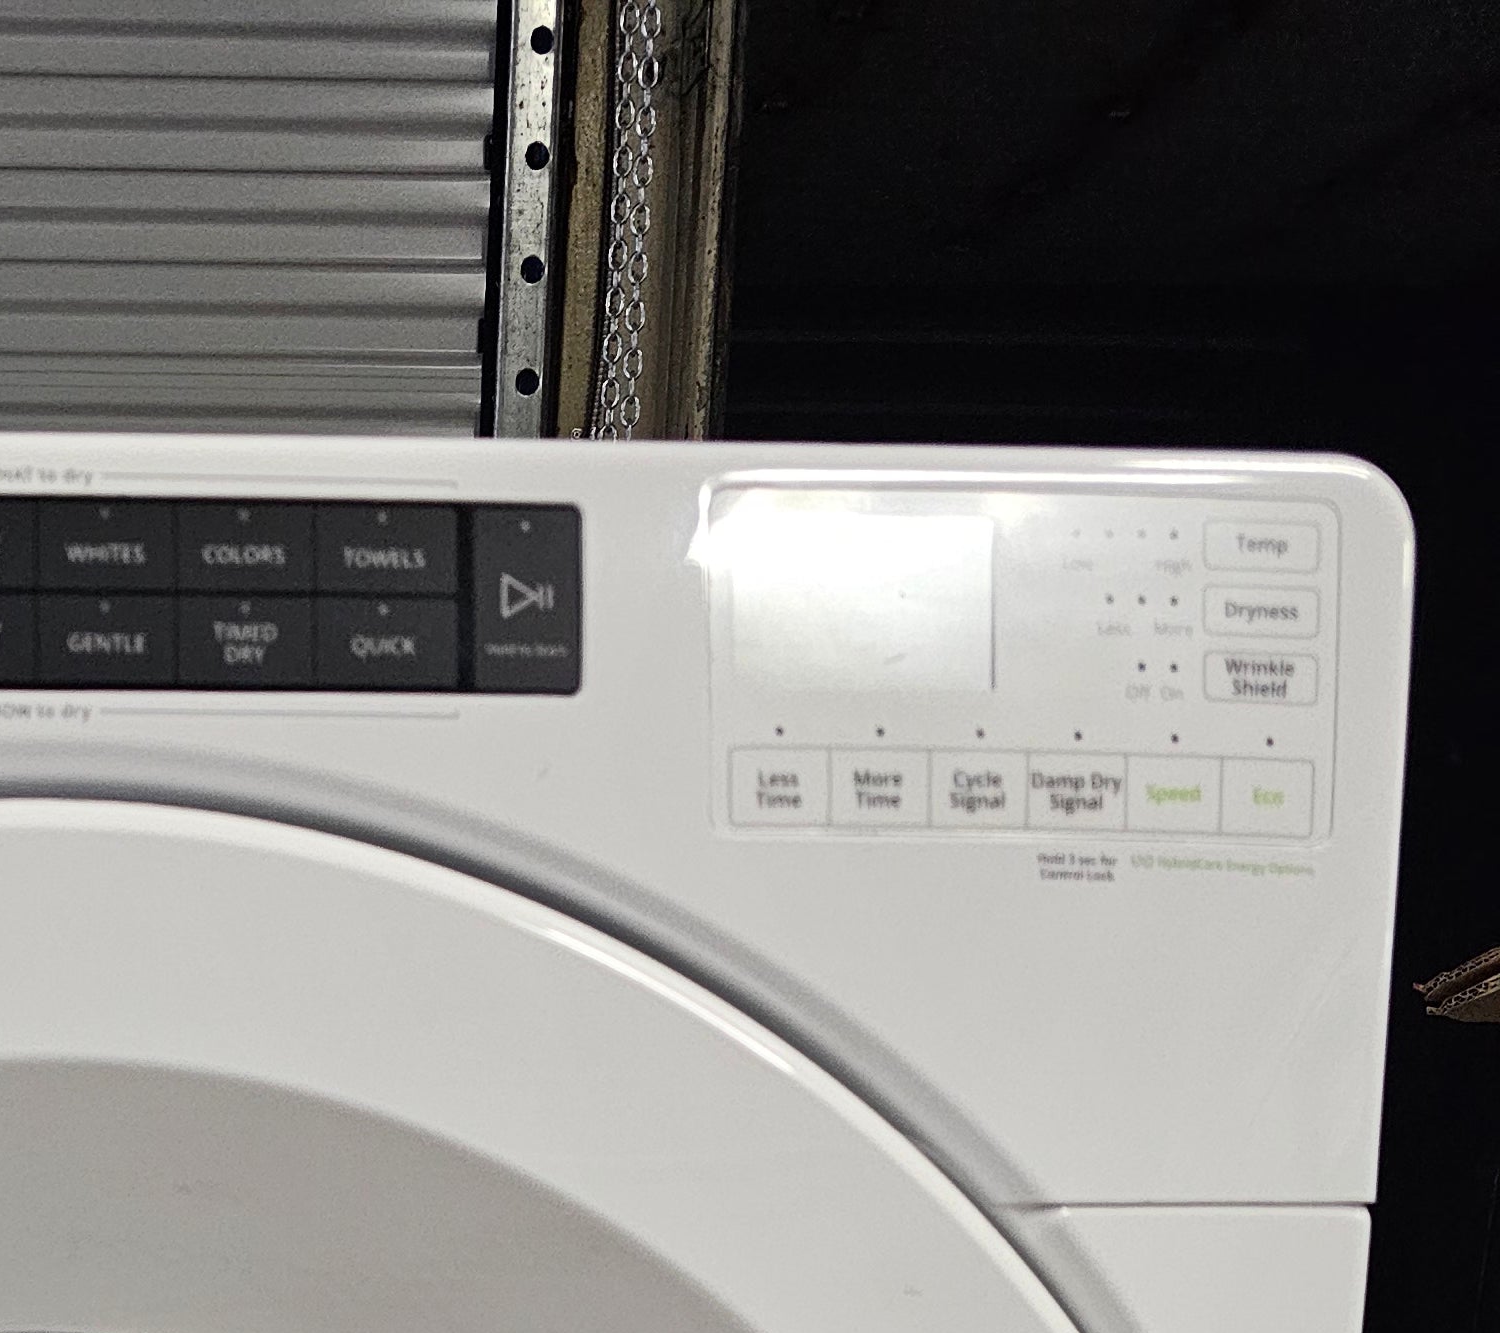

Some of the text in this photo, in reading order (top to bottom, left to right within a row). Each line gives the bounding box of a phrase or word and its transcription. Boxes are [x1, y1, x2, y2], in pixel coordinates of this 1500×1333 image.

[64, 542, 147, 565] WHITES
[202, 543, 286, 566] COLORS
[1235, 534, 1289, 557] Temp
[343, 546, 426, 570] TOWELS
[1224, 602, 1299, 624] Dryness
[66, 632, 148, 655] GENTLE
[224, 644, 264, 665] DRY
[350, 634, 416, 657] QUICK
[1224, 658, 1296, 677] Wrinkle
[1232, 679, 1288, 699] Shield
[757, 770, 799, 788] Less
[853, 770, 903, 788] More
[953, 770, 1004, 791] Cycle
[1031, 770, 1122, 794] Damp Dry
[756, 791, 802, 810] Time
[855, 791, 902, 810] Time
[949, 790, 1006, 812] Signal
[1049, 793, 1104, 815] Signal
[1146, 783, 1202, 806] Speed
